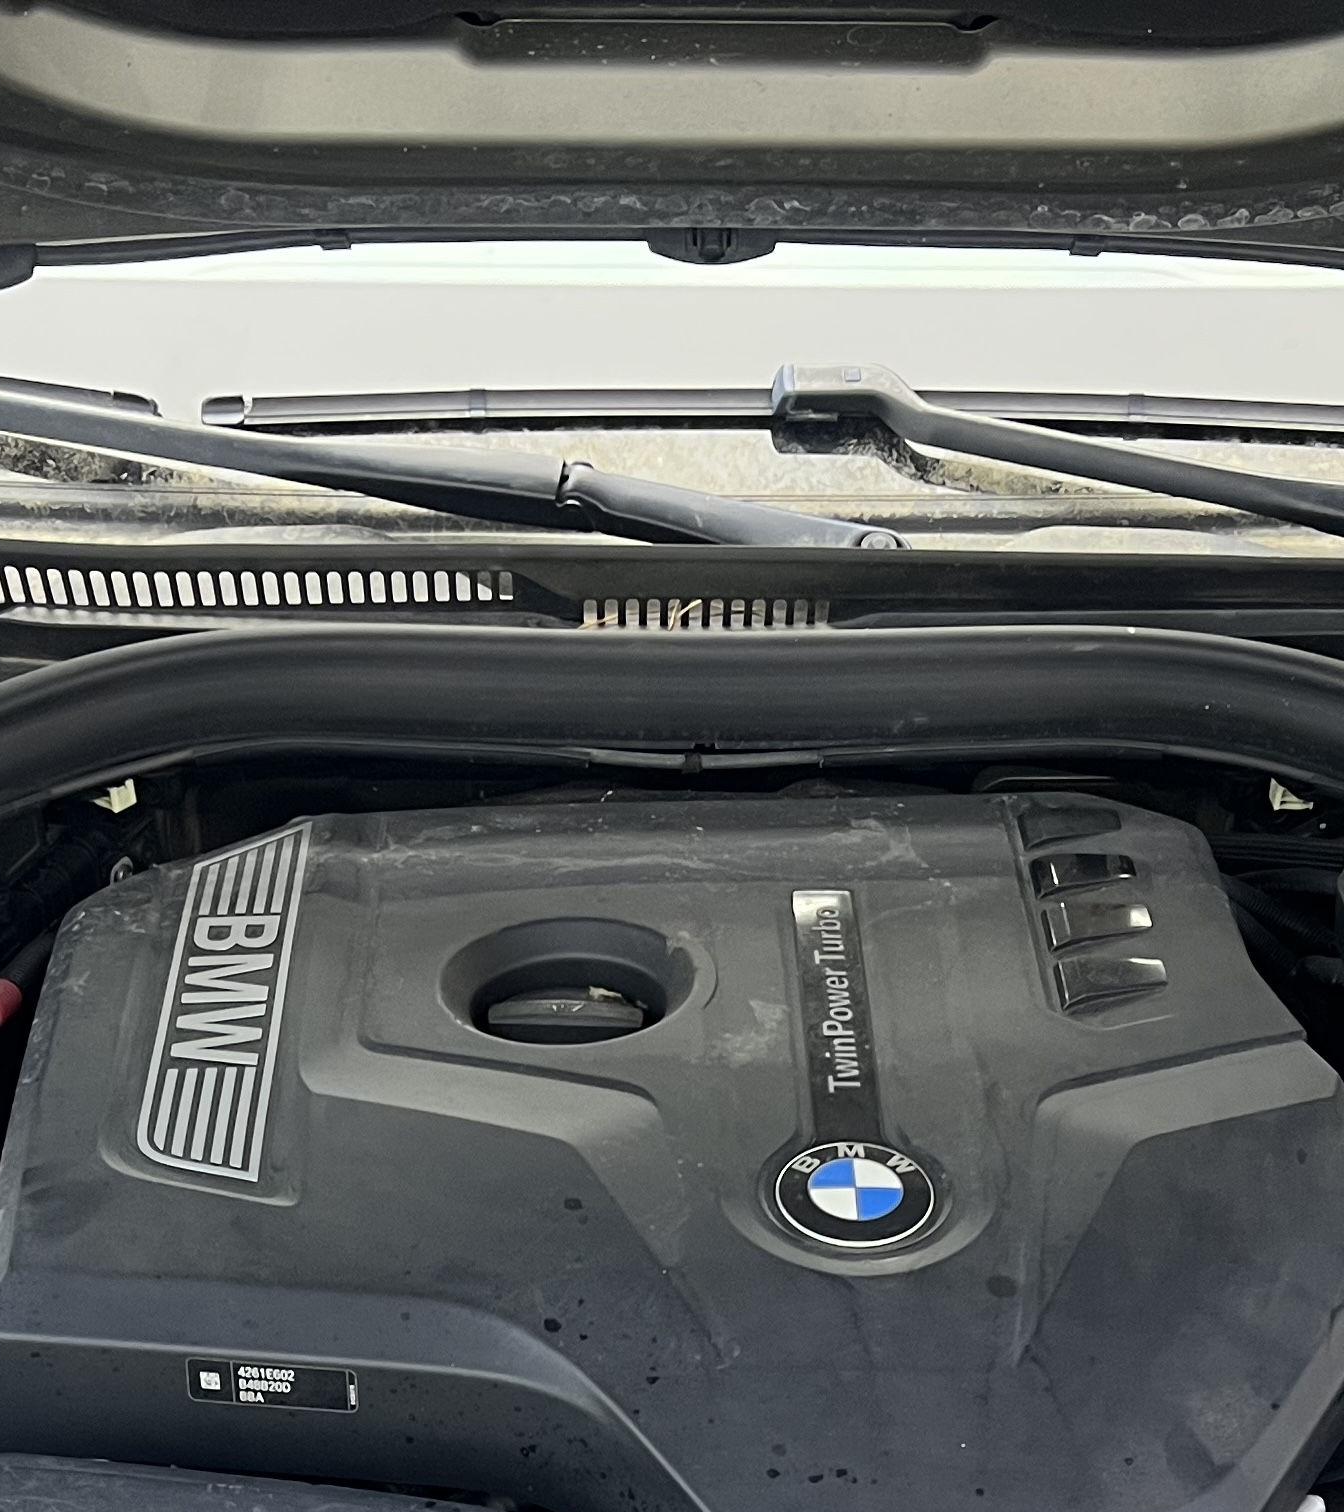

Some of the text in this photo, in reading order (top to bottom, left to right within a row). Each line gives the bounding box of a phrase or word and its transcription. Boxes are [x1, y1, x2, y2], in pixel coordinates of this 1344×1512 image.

[169, 913, 282, 1067] BMW
[811, 905, 862, 1094] TwinPower Turbo
[791, 1143, 917, 1175] BMW
